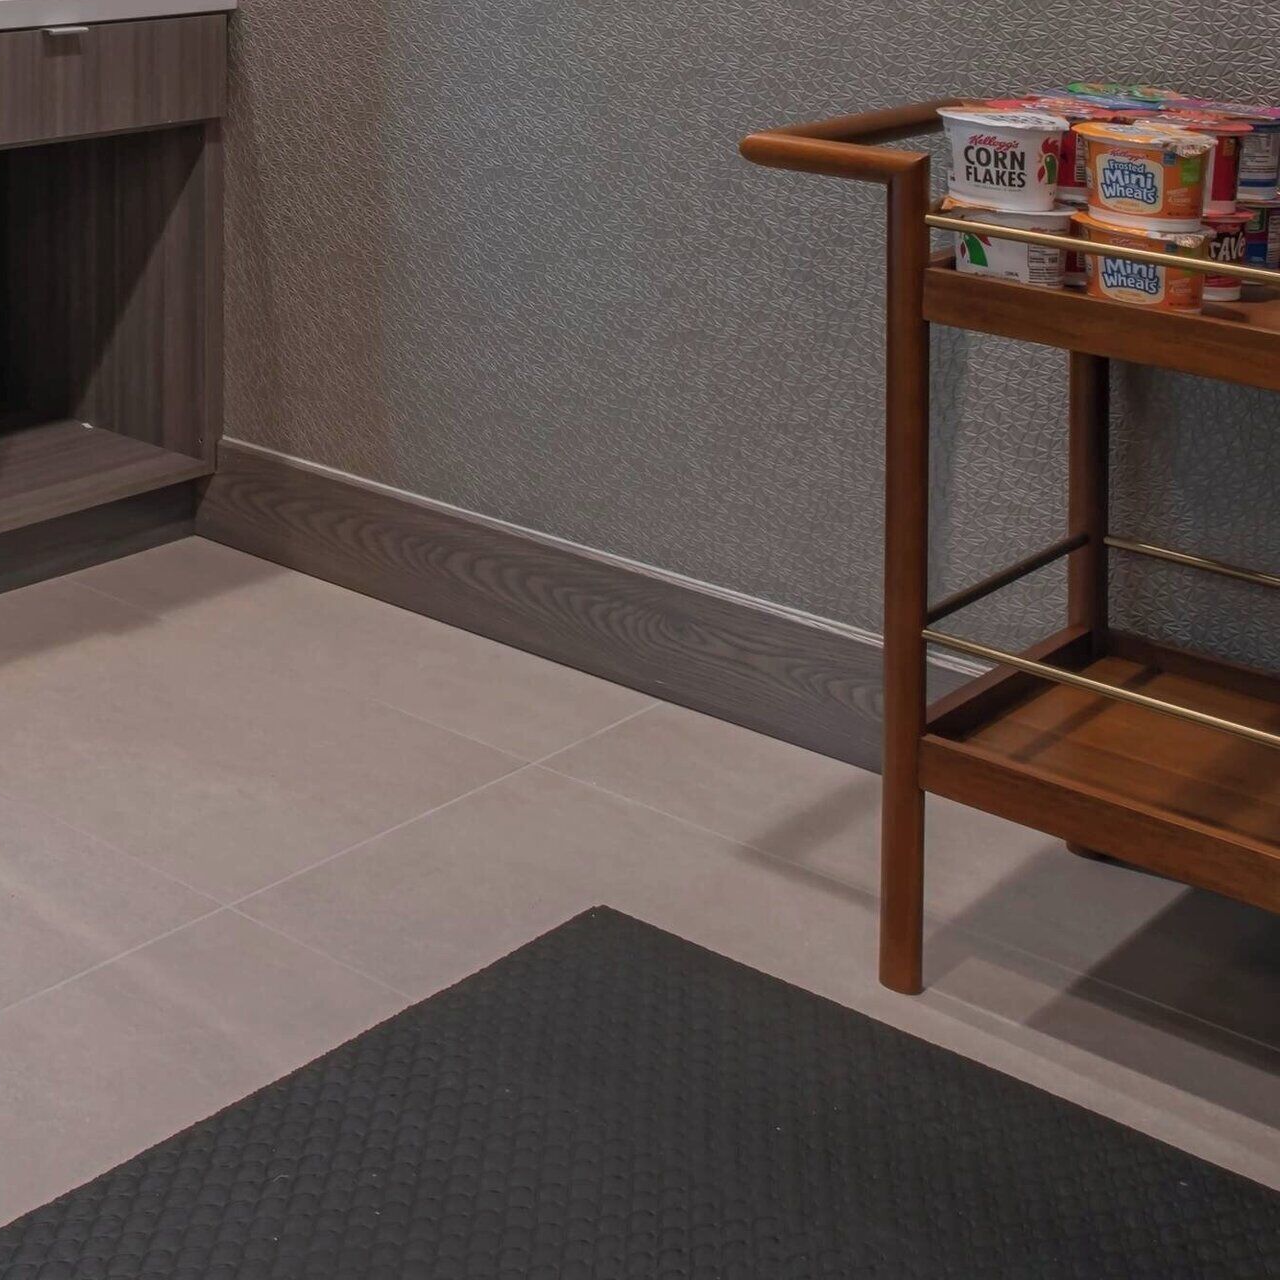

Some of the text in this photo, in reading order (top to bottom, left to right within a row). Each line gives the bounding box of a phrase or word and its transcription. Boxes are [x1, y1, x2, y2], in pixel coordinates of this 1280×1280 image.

[968, 133, 1019, 150] Kellogg's
[963, 146, 1026, 171] CORN
[1107, 158, 1146, 173] Frosted
[966, 165, 1027, 188] FLAKES
[1104, 170, 1156, 189] Mini
[1102, 182, 1158, 205] Wheats
[1104, 274, 1159, 294] Wheats
